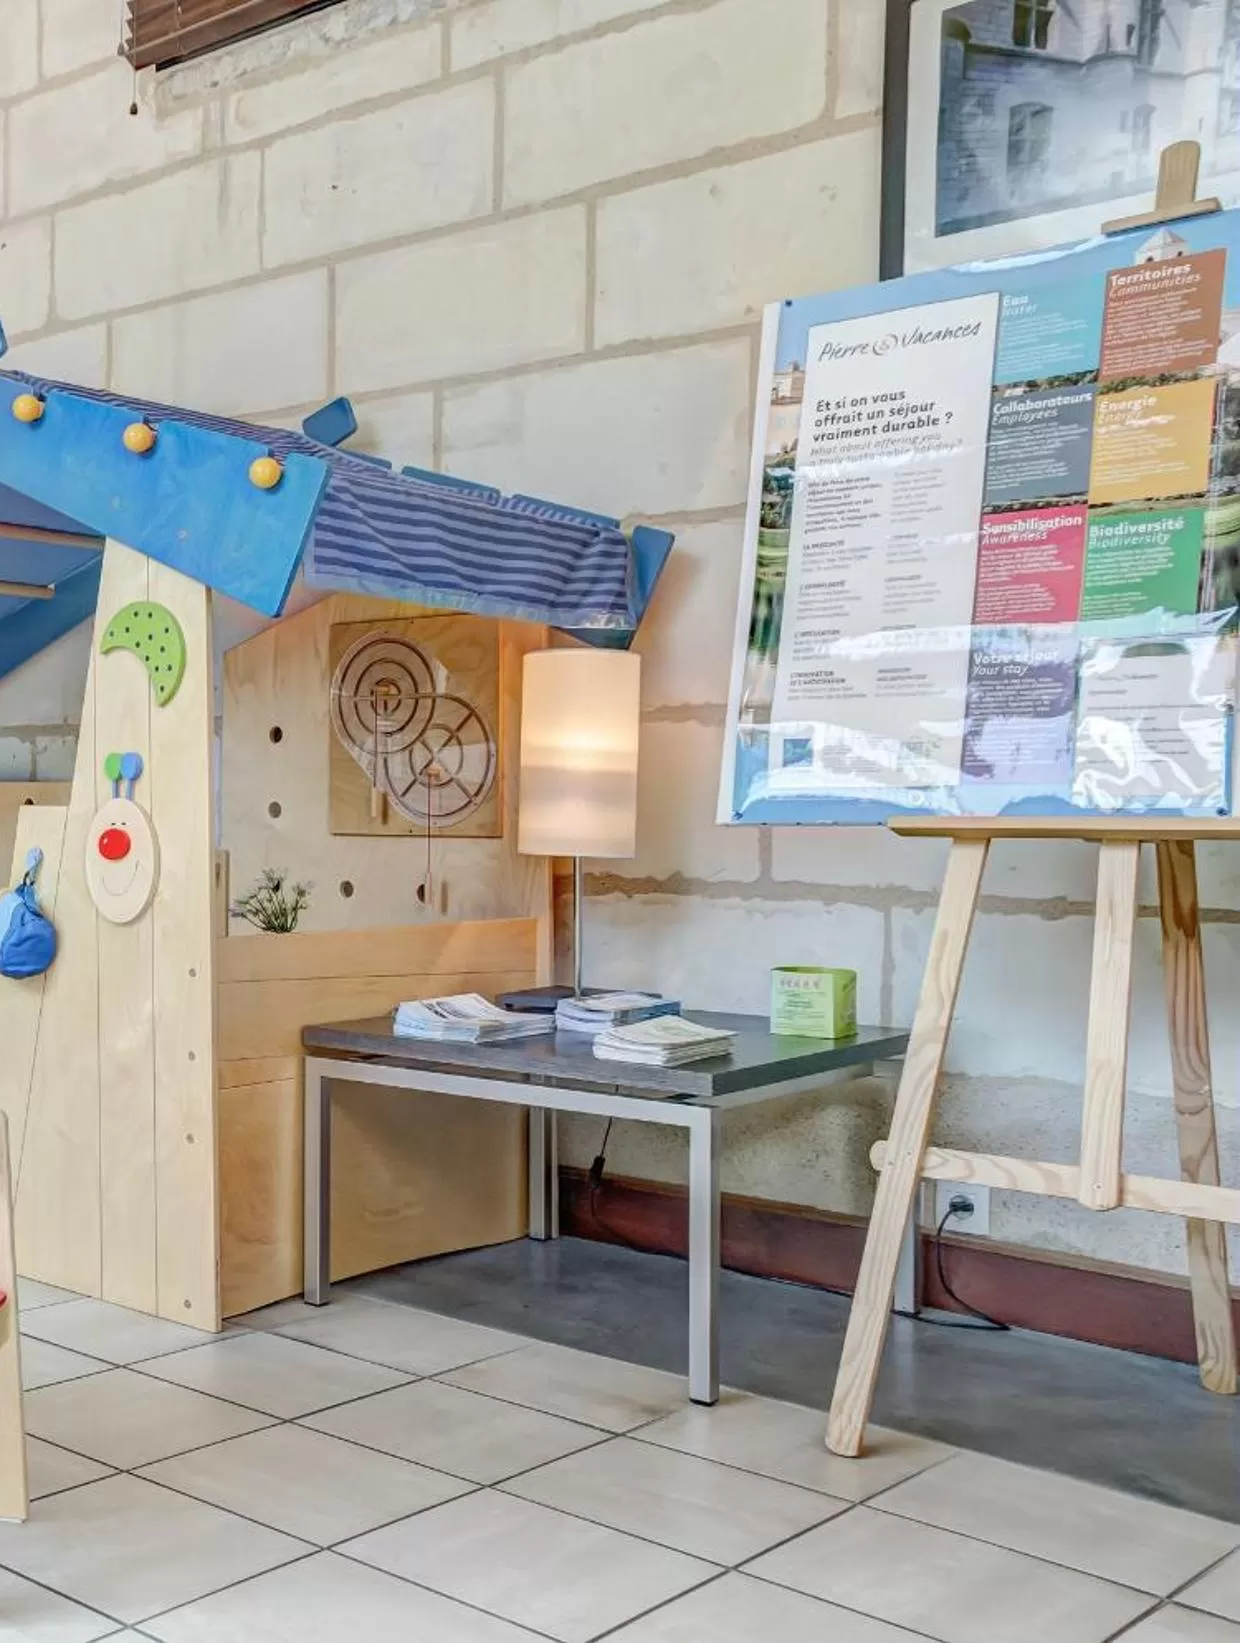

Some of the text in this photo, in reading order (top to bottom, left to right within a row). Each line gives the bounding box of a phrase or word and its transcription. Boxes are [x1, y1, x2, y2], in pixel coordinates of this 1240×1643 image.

[1108, 273, 1201, 298] Communities
[1109, 262, 1193, 287] Territoires
[818, 341, 870, 361] Pierre
[901, 321, 982, 347] Vacances
[816, 390, 906, 413] Et si on vous
[993, 392, 1093, 415] Collaborateurs
[814, 401, 936, 428] offrait un séjour
[992, 408, 1059, 425] Employees
[813, 411, 953, 442] vraiment durable ?
[982, 515, 1083, 535] Sensibilisation
[1090, 516, 1185, 537] Biodiversité
[981, 530, 1049, 545] Awareness
[1088, 531, 1172, 549] Biodiversity
[972, 665, 1029, 676] Your stay
